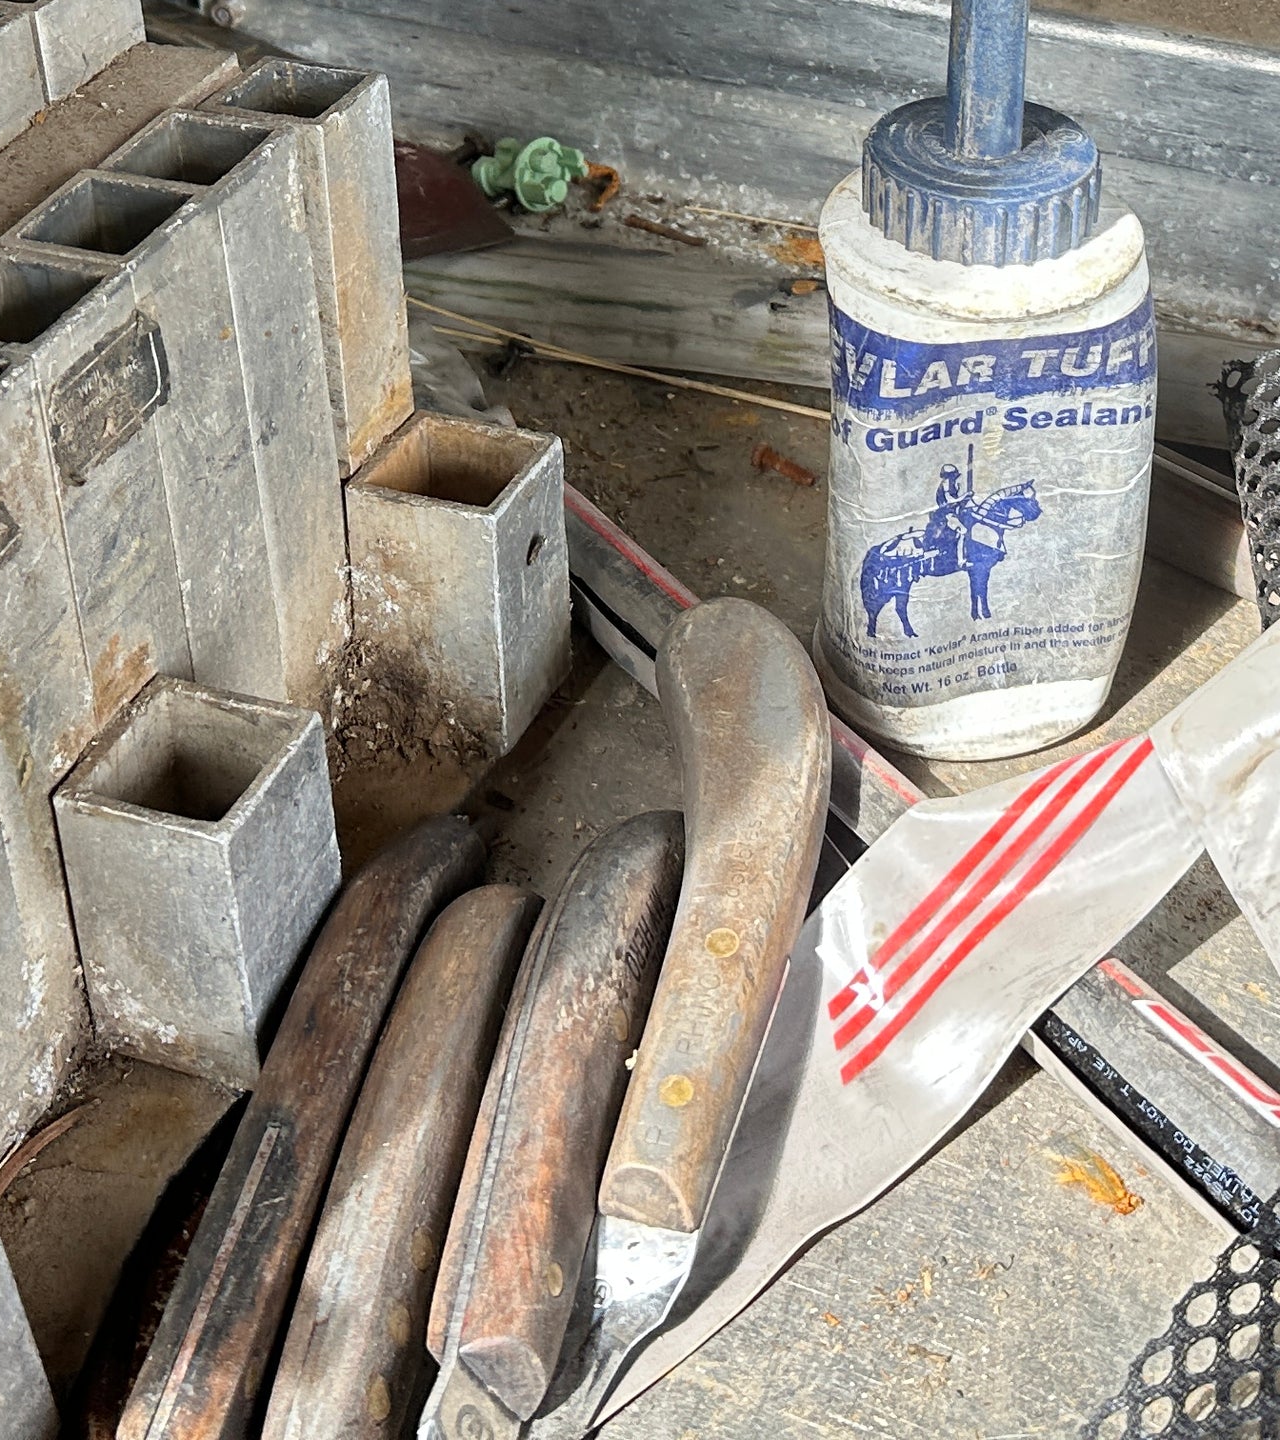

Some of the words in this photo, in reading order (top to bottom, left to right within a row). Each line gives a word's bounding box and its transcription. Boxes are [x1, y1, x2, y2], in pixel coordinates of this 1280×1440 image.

[831, 324, 996, 398] EVLAR
[879, 665, 915, 678] keeps
[918, 654, 956, 674] natural
[958, 644, 1007, 662] moisture
[1010, 641, 1021, 651] in
[1024, 639, 1047, 650] and
[1050, 639, 1070, 648] the
[1072, 633, 1117, 648] weather
[880, 649, 921, 662] impact
[970, 627, 1010, 644] Aramid
[1013, 625, 1044, 636] Fiber
[1047, 623, 1085, 634] added
[1088, 621, 1105, 633] for
[882, 682, 907, 694] Net
[937, 674, 951, 689] 16
[977, 661, 1018, 678] Bottle
